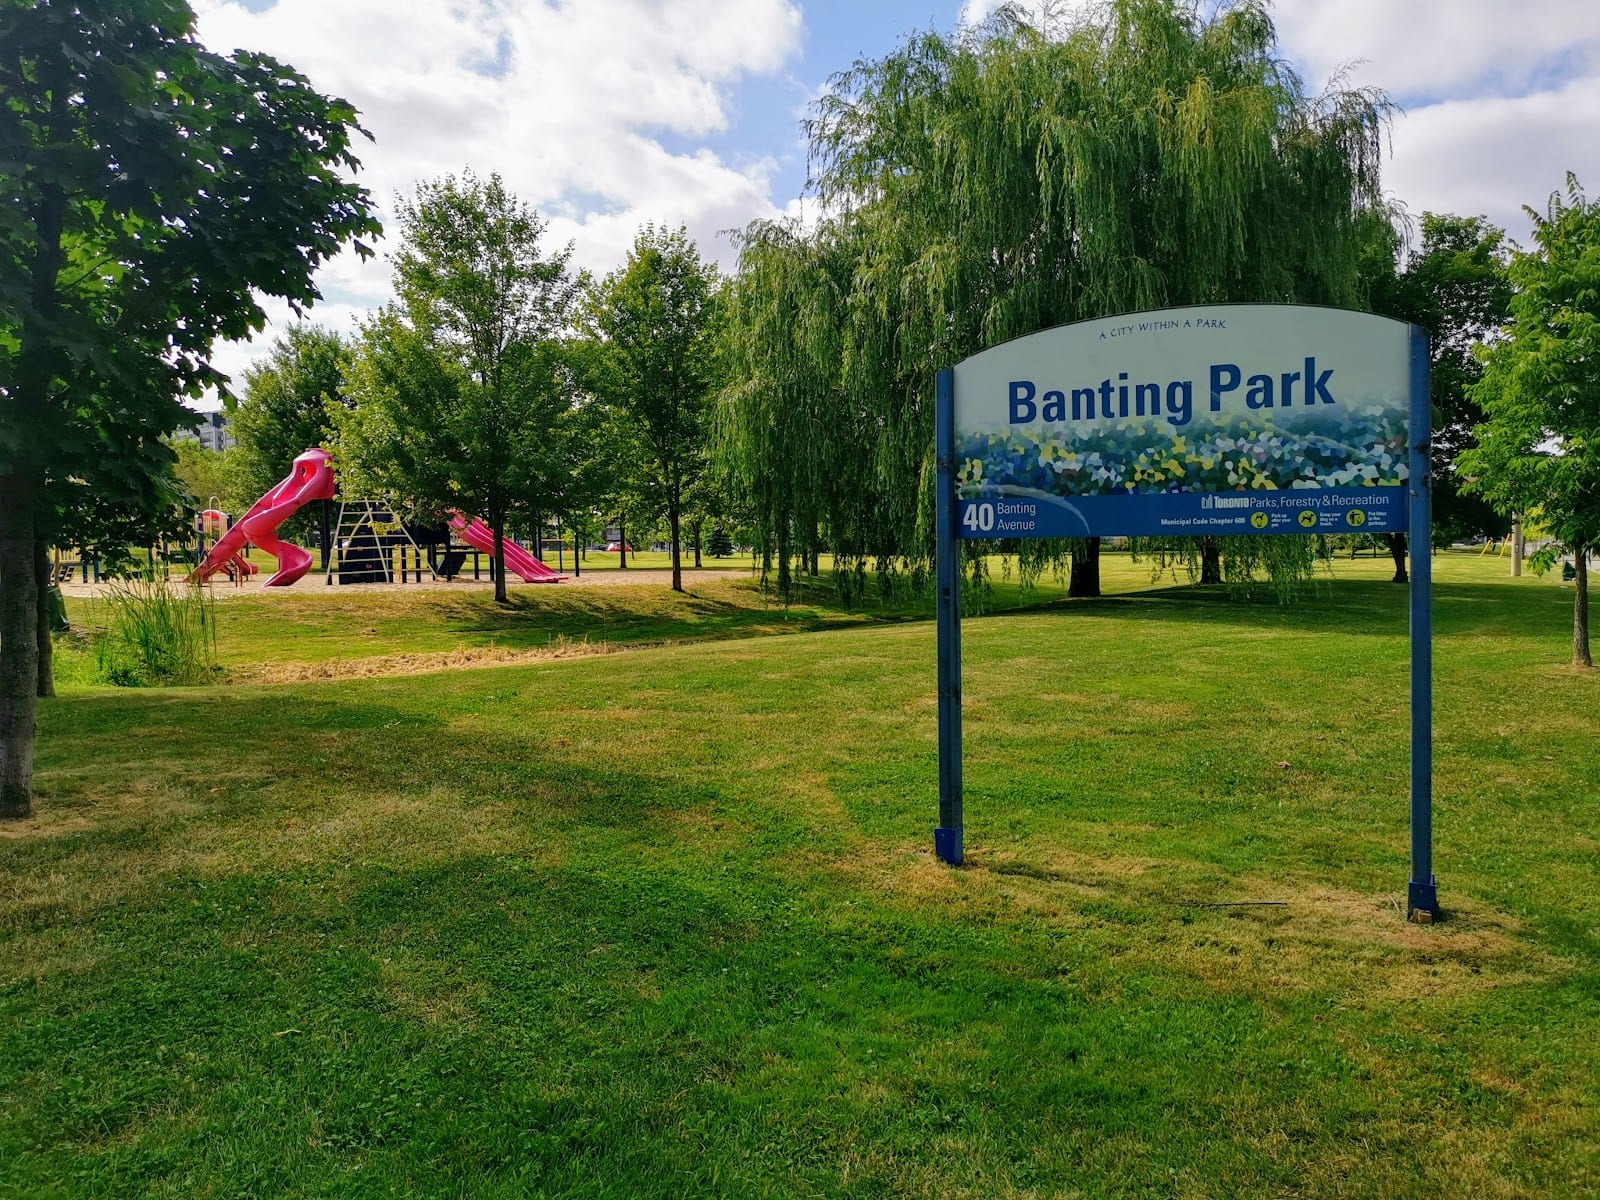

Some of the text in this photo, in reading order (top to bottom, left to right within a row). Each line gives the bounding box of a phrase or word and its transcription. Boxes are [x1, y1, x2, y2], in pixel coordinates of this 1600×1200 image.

[1099, 318, 1227, 340] A CITY WITHIN A PARK
[1008, 356, 1336, 426] Banting Park
[997, 502, 1036, 516] Banting
[1213, 494, 1389, 509] TORONTO Parks, Forestry & Recreation
[962, 503, 994, 531] 40
[1160, 518, 1192, 527] Municipal
[1209, 517, 1234, 526] Chapter
[997, 519, 1035, 531] Avenue
